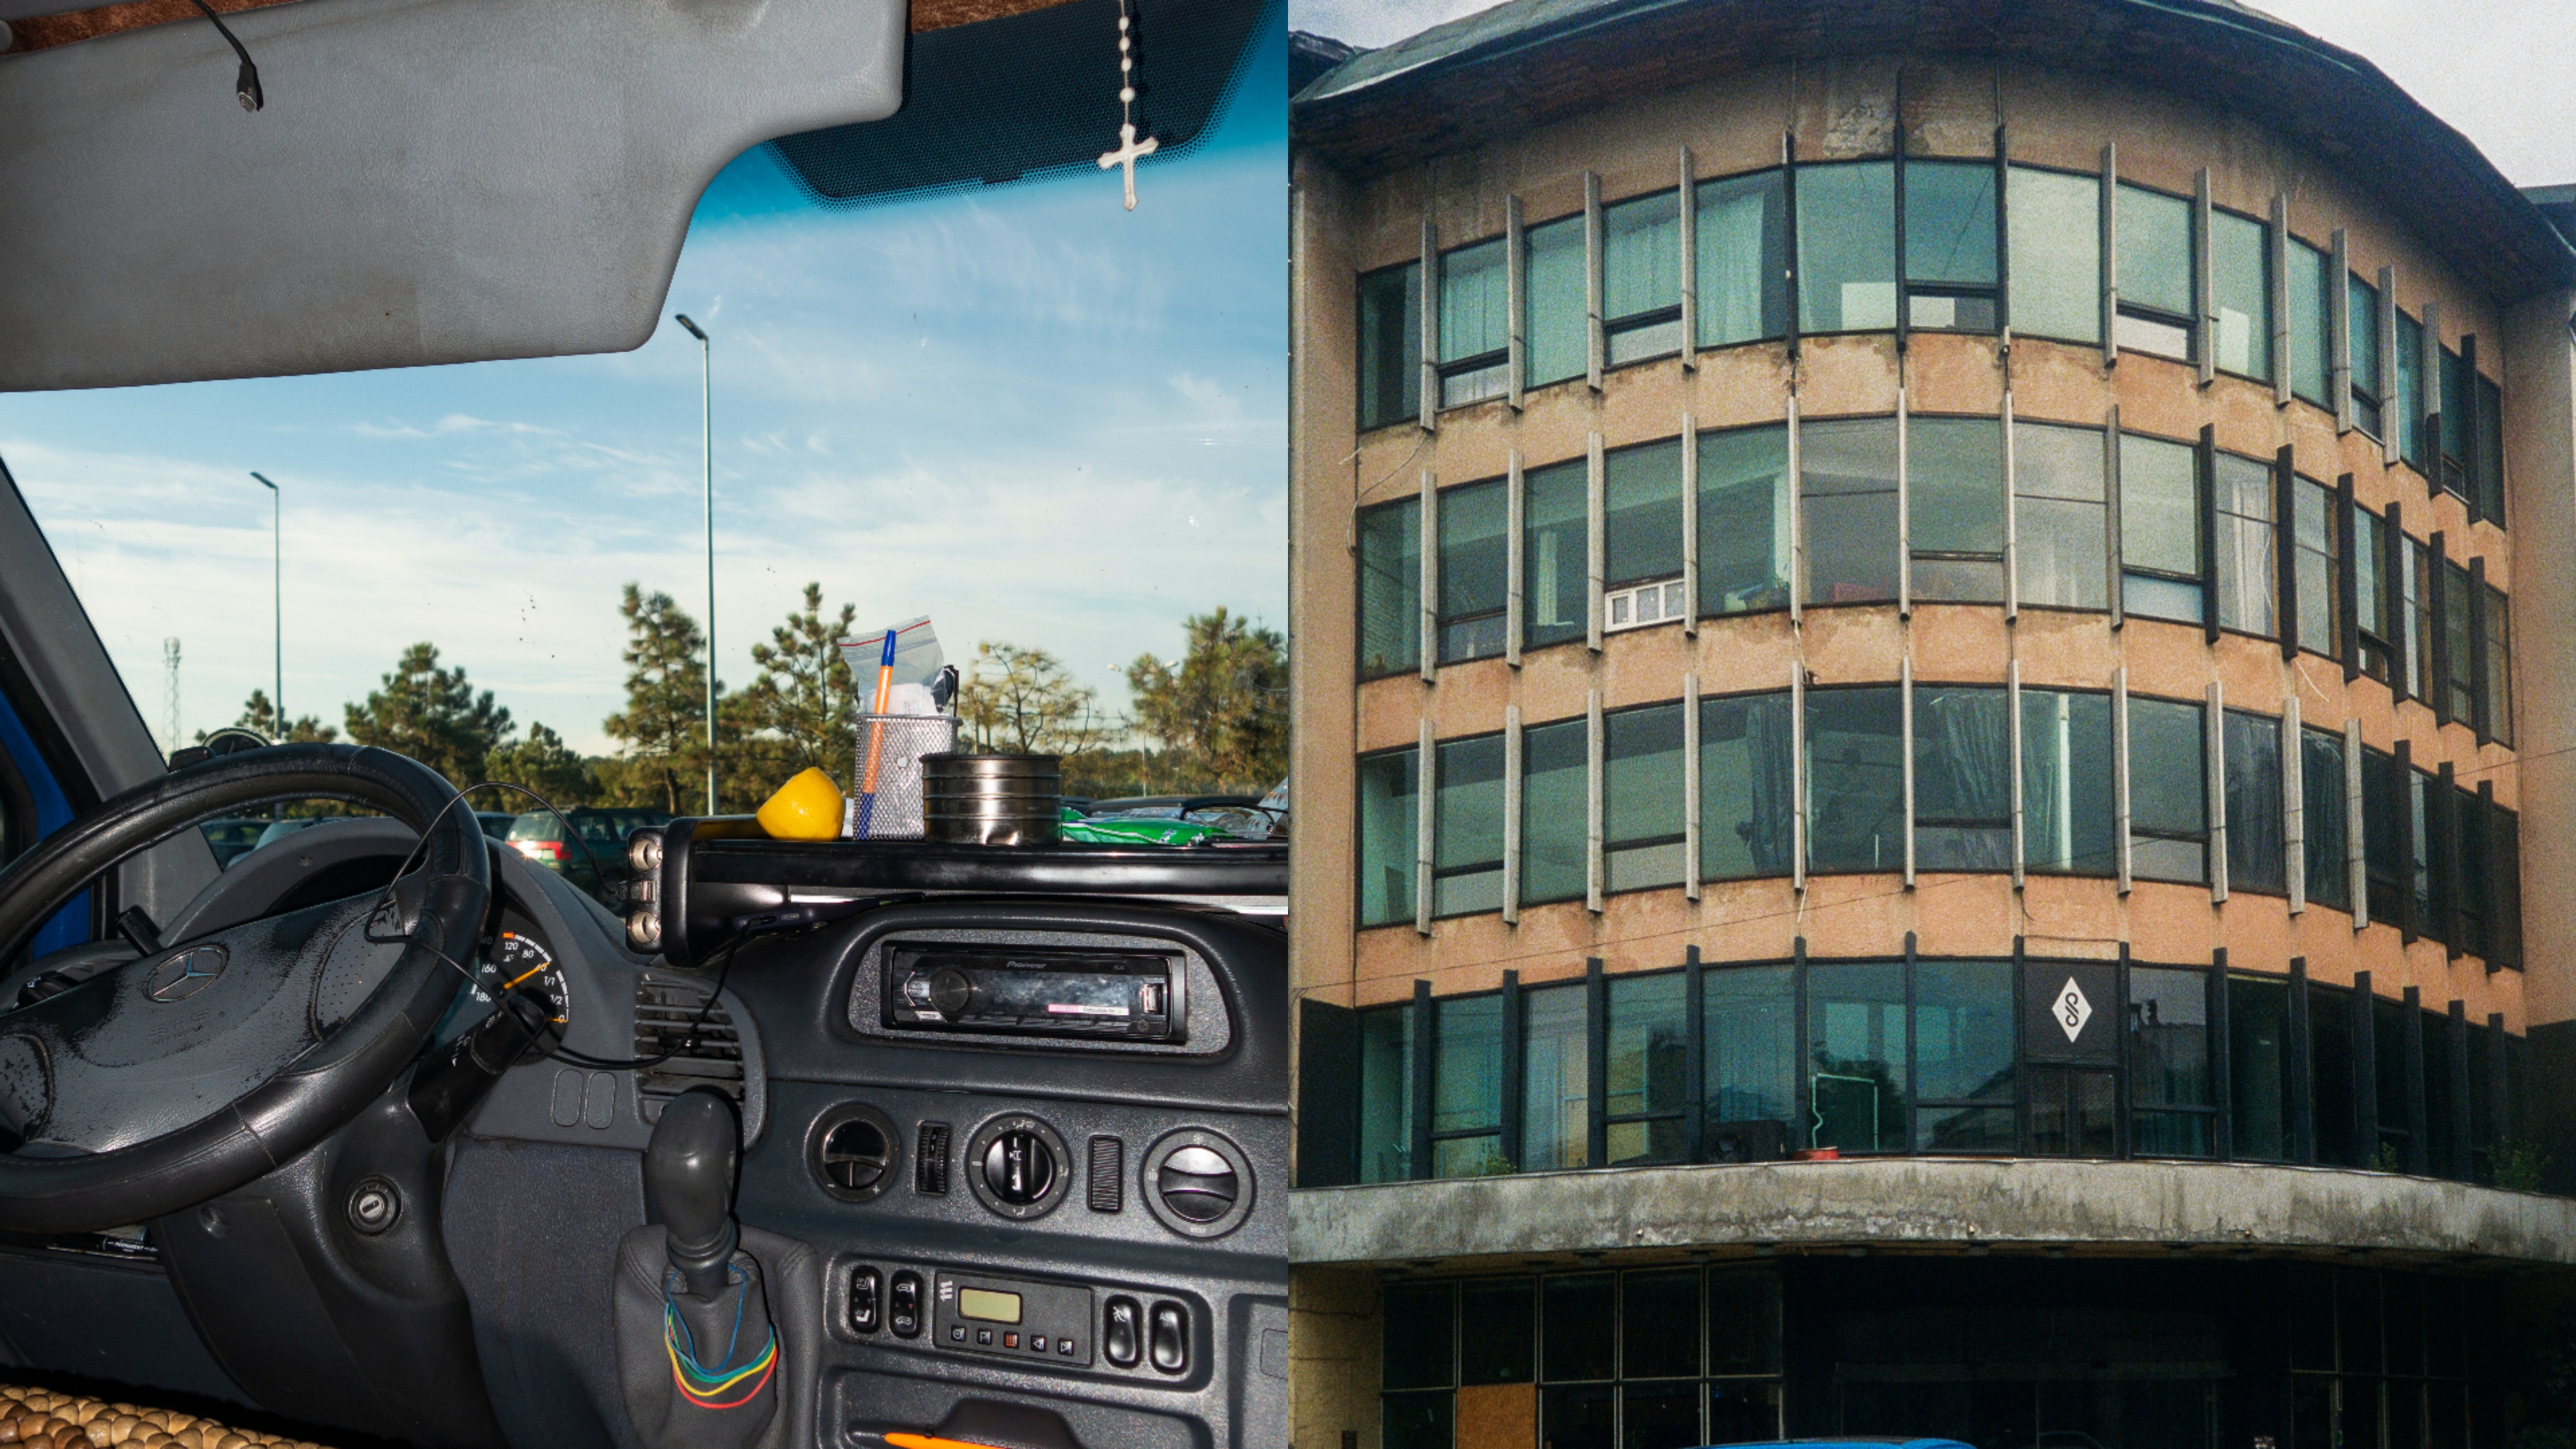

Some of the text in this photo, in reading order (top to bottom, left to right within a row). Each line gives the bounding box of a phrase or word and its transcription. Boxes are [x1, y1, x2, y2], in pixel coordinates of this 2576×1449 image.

[504, 941, 519, 950] 120
[522, 949, 534, 958] 80
[482, 963, 497, 973] 160
[1007, 961, 1046, 969] Pioneer
[476, 992, 491, 1002] 180
[550, 994, 563, 1005] 1/2
[1159, 1311, 1175, 1322] AS
[979, 1332, 987, 1342] P
